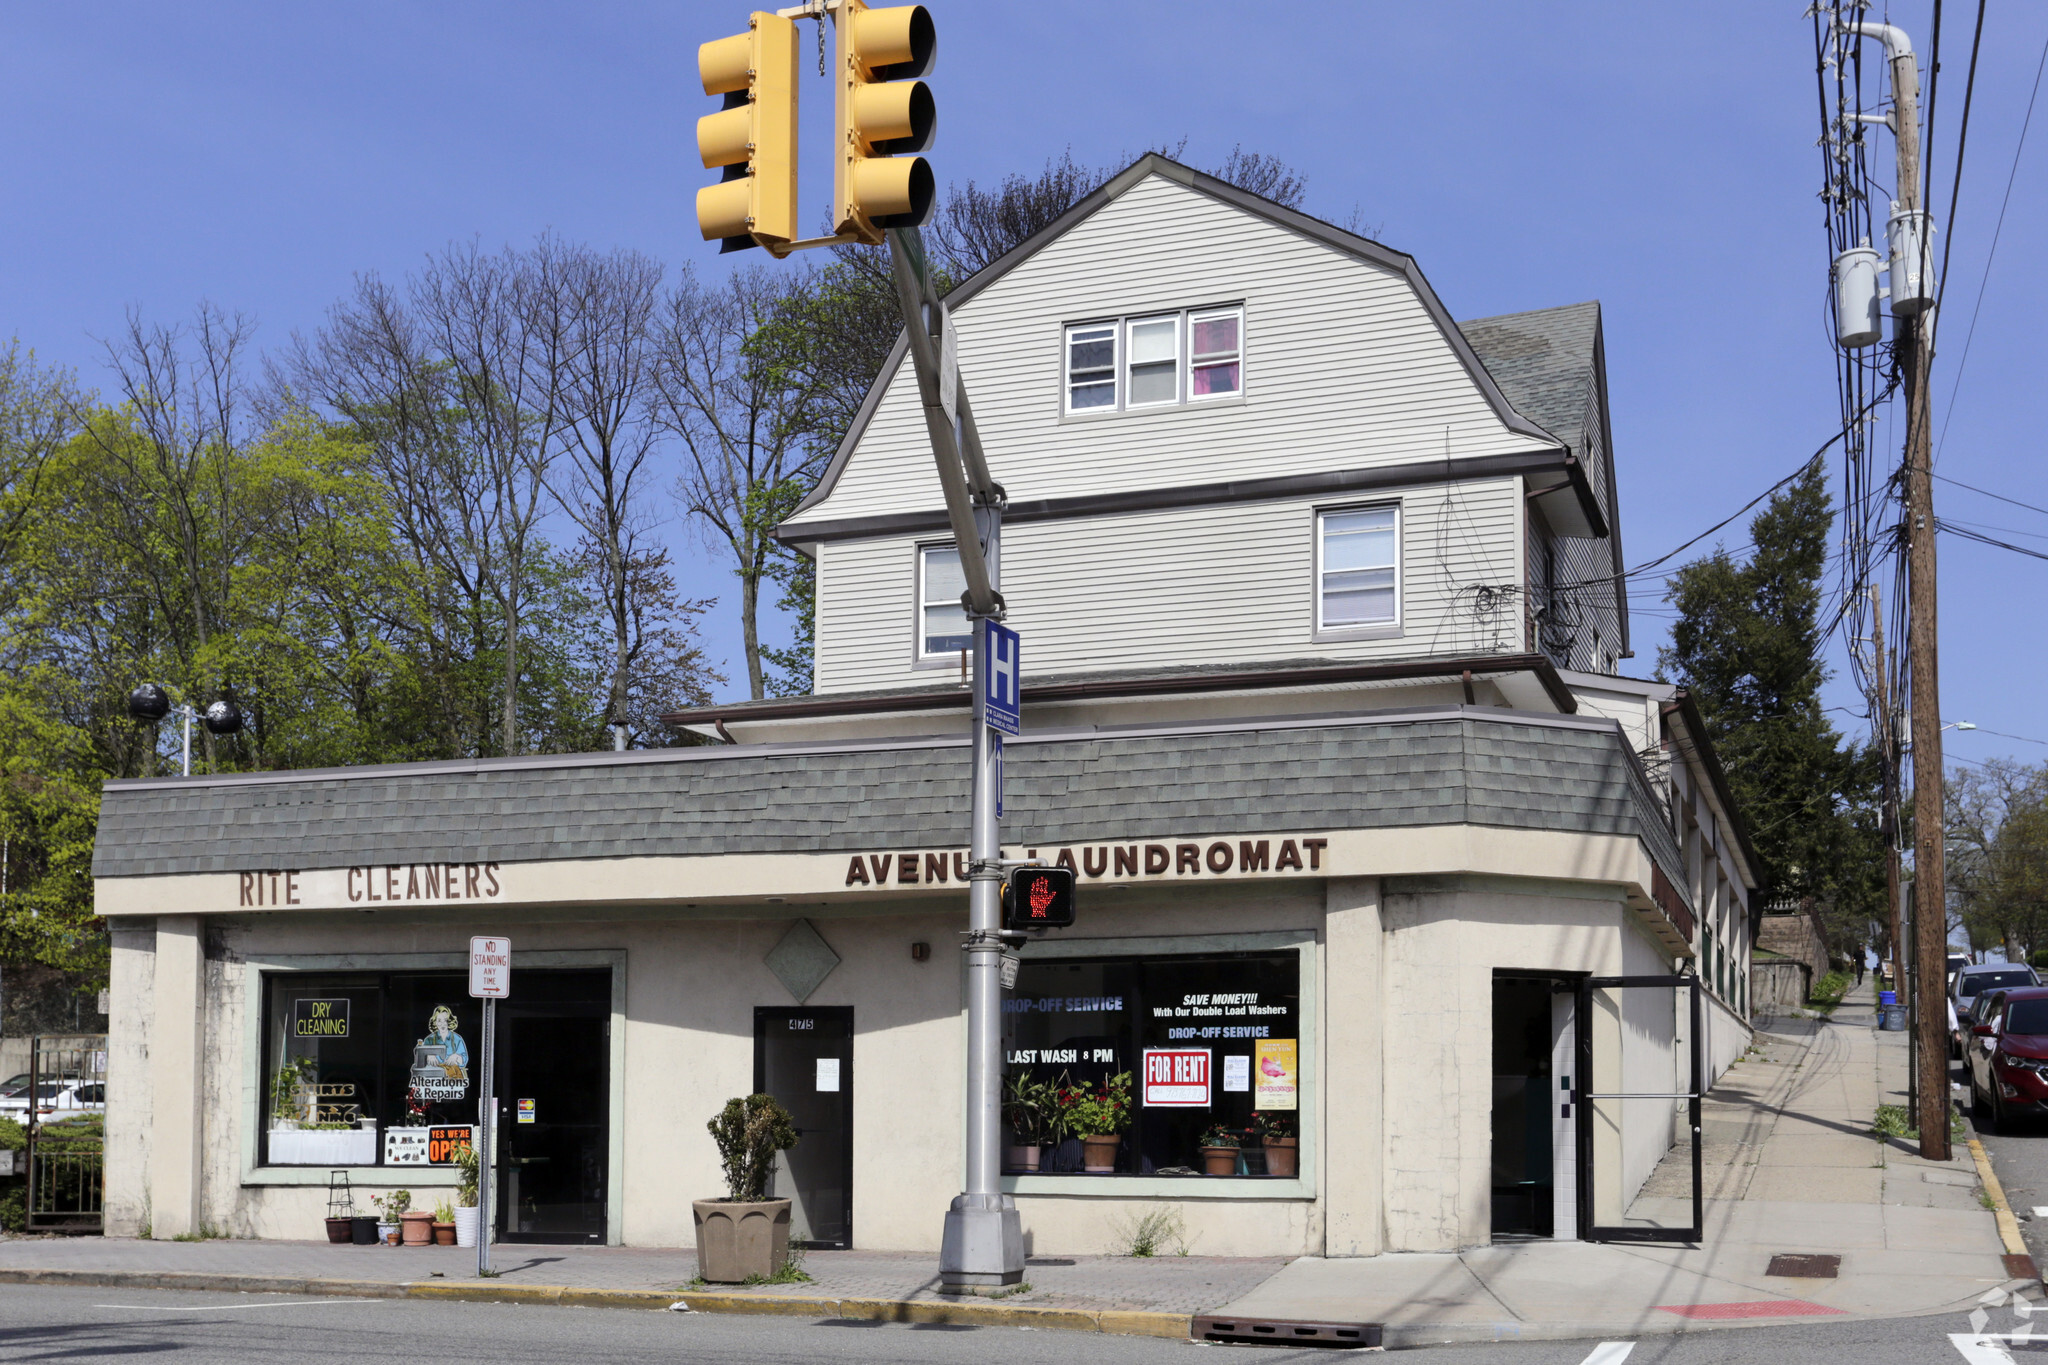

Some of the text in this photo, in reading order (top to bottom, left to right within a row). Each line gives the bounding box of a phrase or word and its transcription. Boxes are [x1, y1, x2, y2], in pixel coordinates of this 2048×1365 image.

[991, 630, 1014, 706] H
[845, 851, 1004, 885] AVENU
[240, 861, 500, 907] RITE CLEANERS
[485, 941, 497, 953] NO
[474, 954, 507, 967] STANDING
[484, 967, 497, 976] ANY
[483, 977, 497, 985] TIME
[1001, 996, 1123, 1013] DROP-OFF SERVICE
[1183, 993, 1258, 1006] SAVE MONEY!!!
[312, 1002, 332, 1018] DRY
[1153, 1004, 1287, 1018] With Our Double Load Washers
[297, 1019, 346, 1035] CLEANING
[789, 1019, 814, 1030] 475
[1168, 1026, 1269, 1039] DROP-OFF SERVICE
[1007, 1049, 1113, 1064] LAST WASH 8 PM
[1148, 1055, 1206, 1083] FOR RENT
[409, 1076, 469, 1089] Alterations
[414, 1088, 464, 1102] & Repairs
[431, 1129, 470, 1139] YES WE'RE
